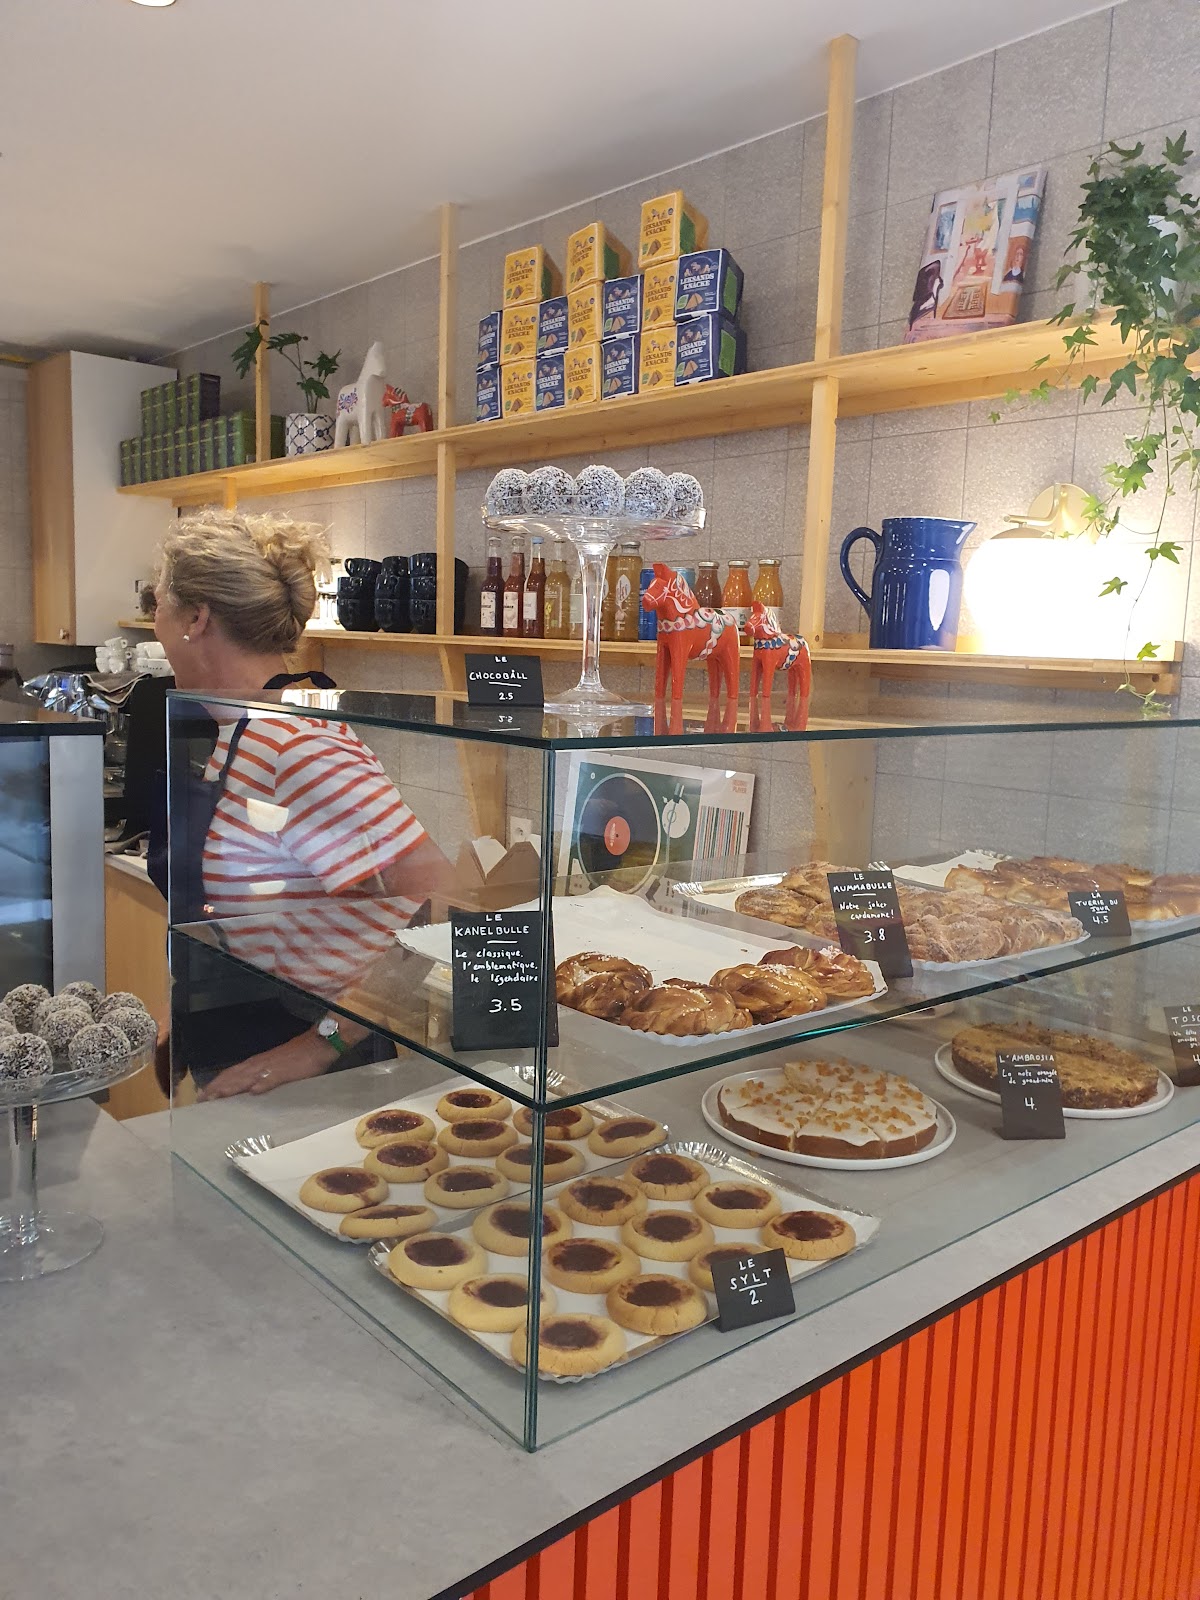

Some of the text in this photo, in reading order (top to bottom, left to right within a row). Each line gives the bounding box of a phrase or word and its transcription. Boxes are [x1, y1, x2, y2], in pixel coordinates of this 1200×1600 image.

[499, 692, 514, 700] 2.5
[833, 882, 892, 892] MUMMABULLE
[840, 902, 860, 910] Notre
[1092, 916, 1109, 924] 4.5
[864, 928, 885, 944] 3.8
[455, 949, 467, 958] Le
[470, 974, 479, 983] le
[489, 998, 522, 1013] 3.5
[739, 1258, 755, 1271] LE
[730, 1268, 771, 1290] SYLT
